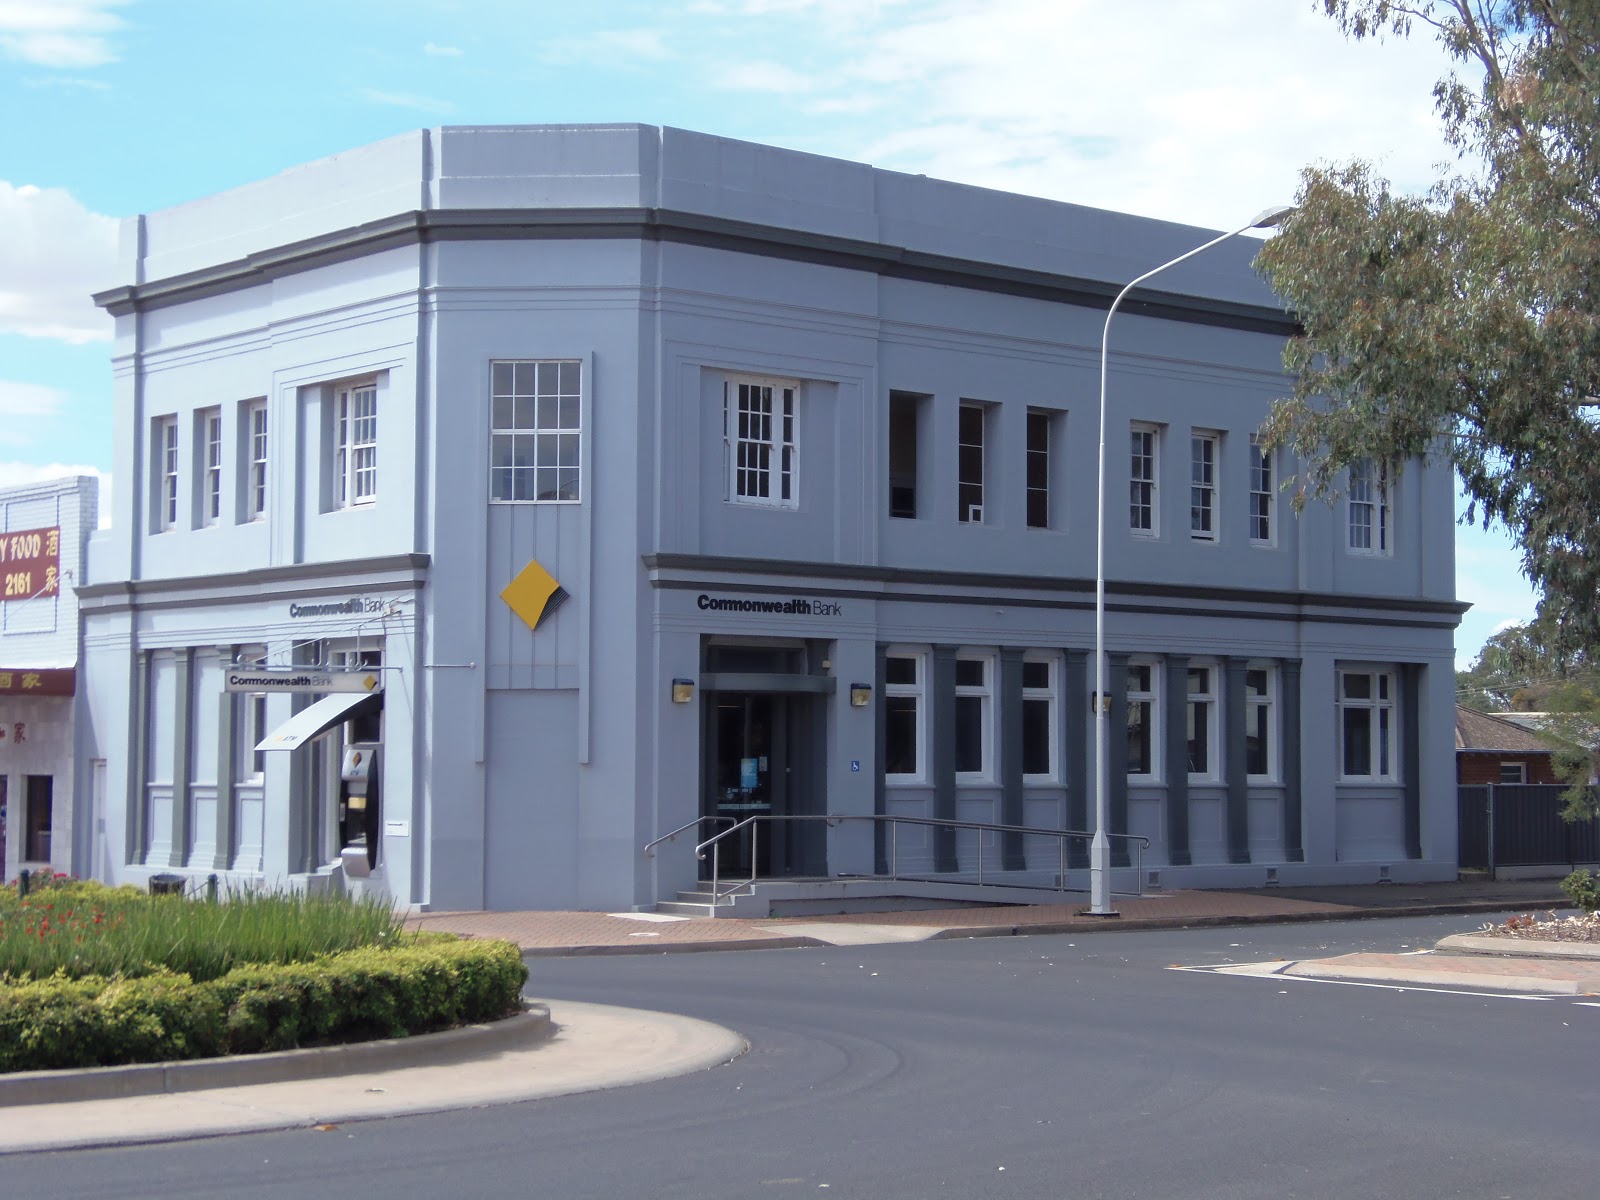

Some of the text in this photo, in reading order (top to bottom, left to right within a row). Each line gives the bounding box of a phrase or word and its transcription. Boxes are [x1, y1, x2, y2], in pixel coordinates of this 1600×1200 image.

[11, 534, 41, 561] FOOD
[5, 572, 31, 596] 2161
[290, 597, 385, 618] Commonwealth Bank
[698, 595, 842, 616] Commonwealth Bank
[230, 675, 333, 686] Commonwealth Bank
